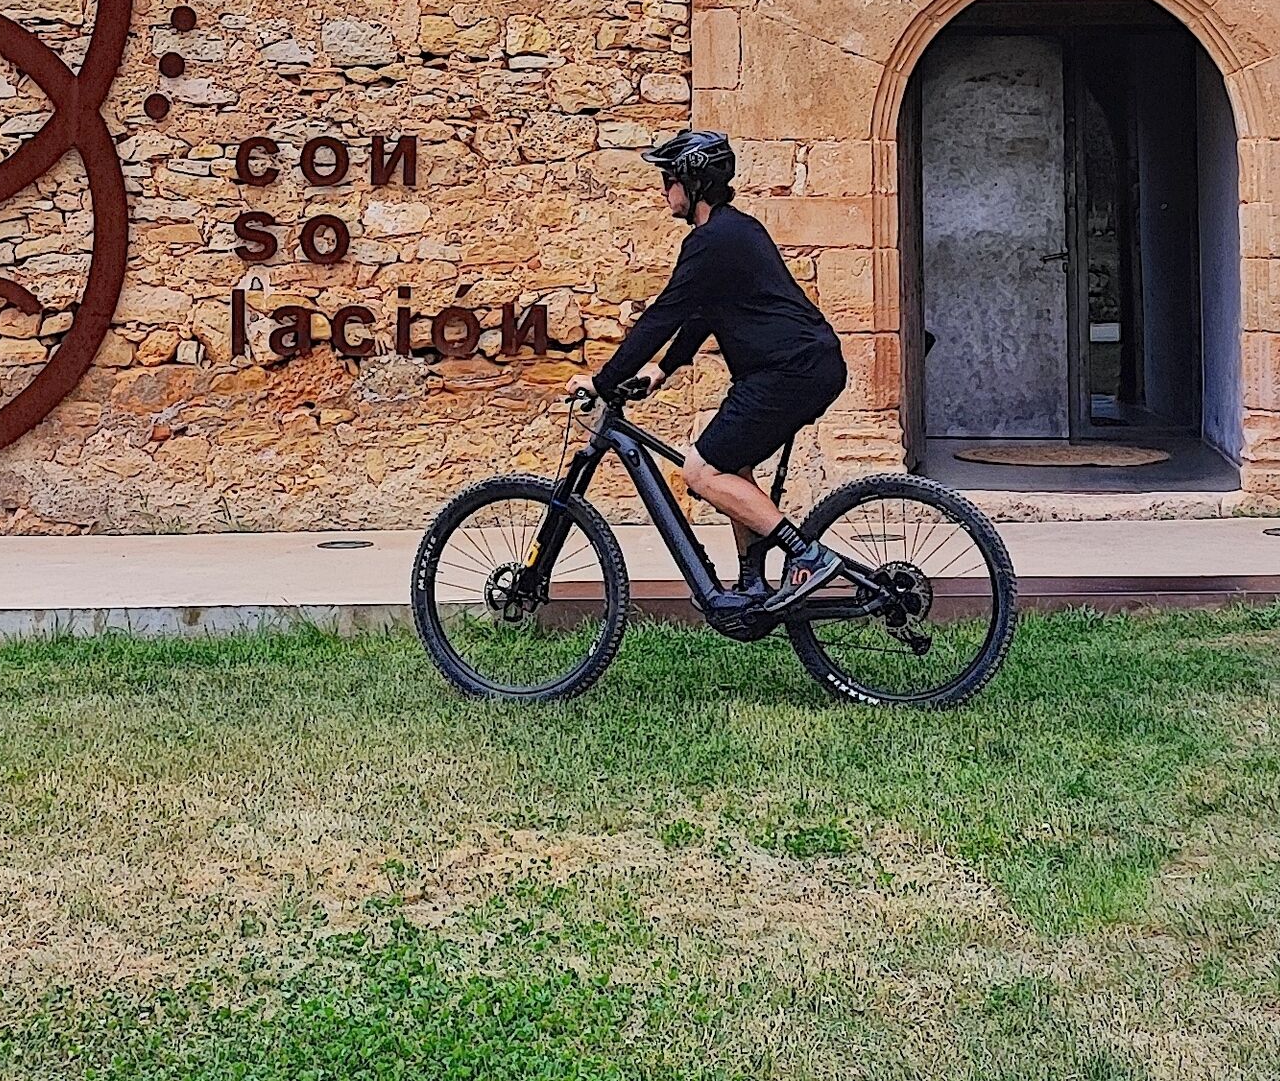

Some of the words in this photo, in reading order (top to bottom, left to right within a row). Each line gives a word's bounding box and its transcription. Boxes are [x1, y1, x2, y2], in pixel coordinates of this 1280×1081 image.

[233, 211, 351, 265] so
[417, 535, 437, 591] MAXXIS
[826, 673, 881, 706] MAXXIS
